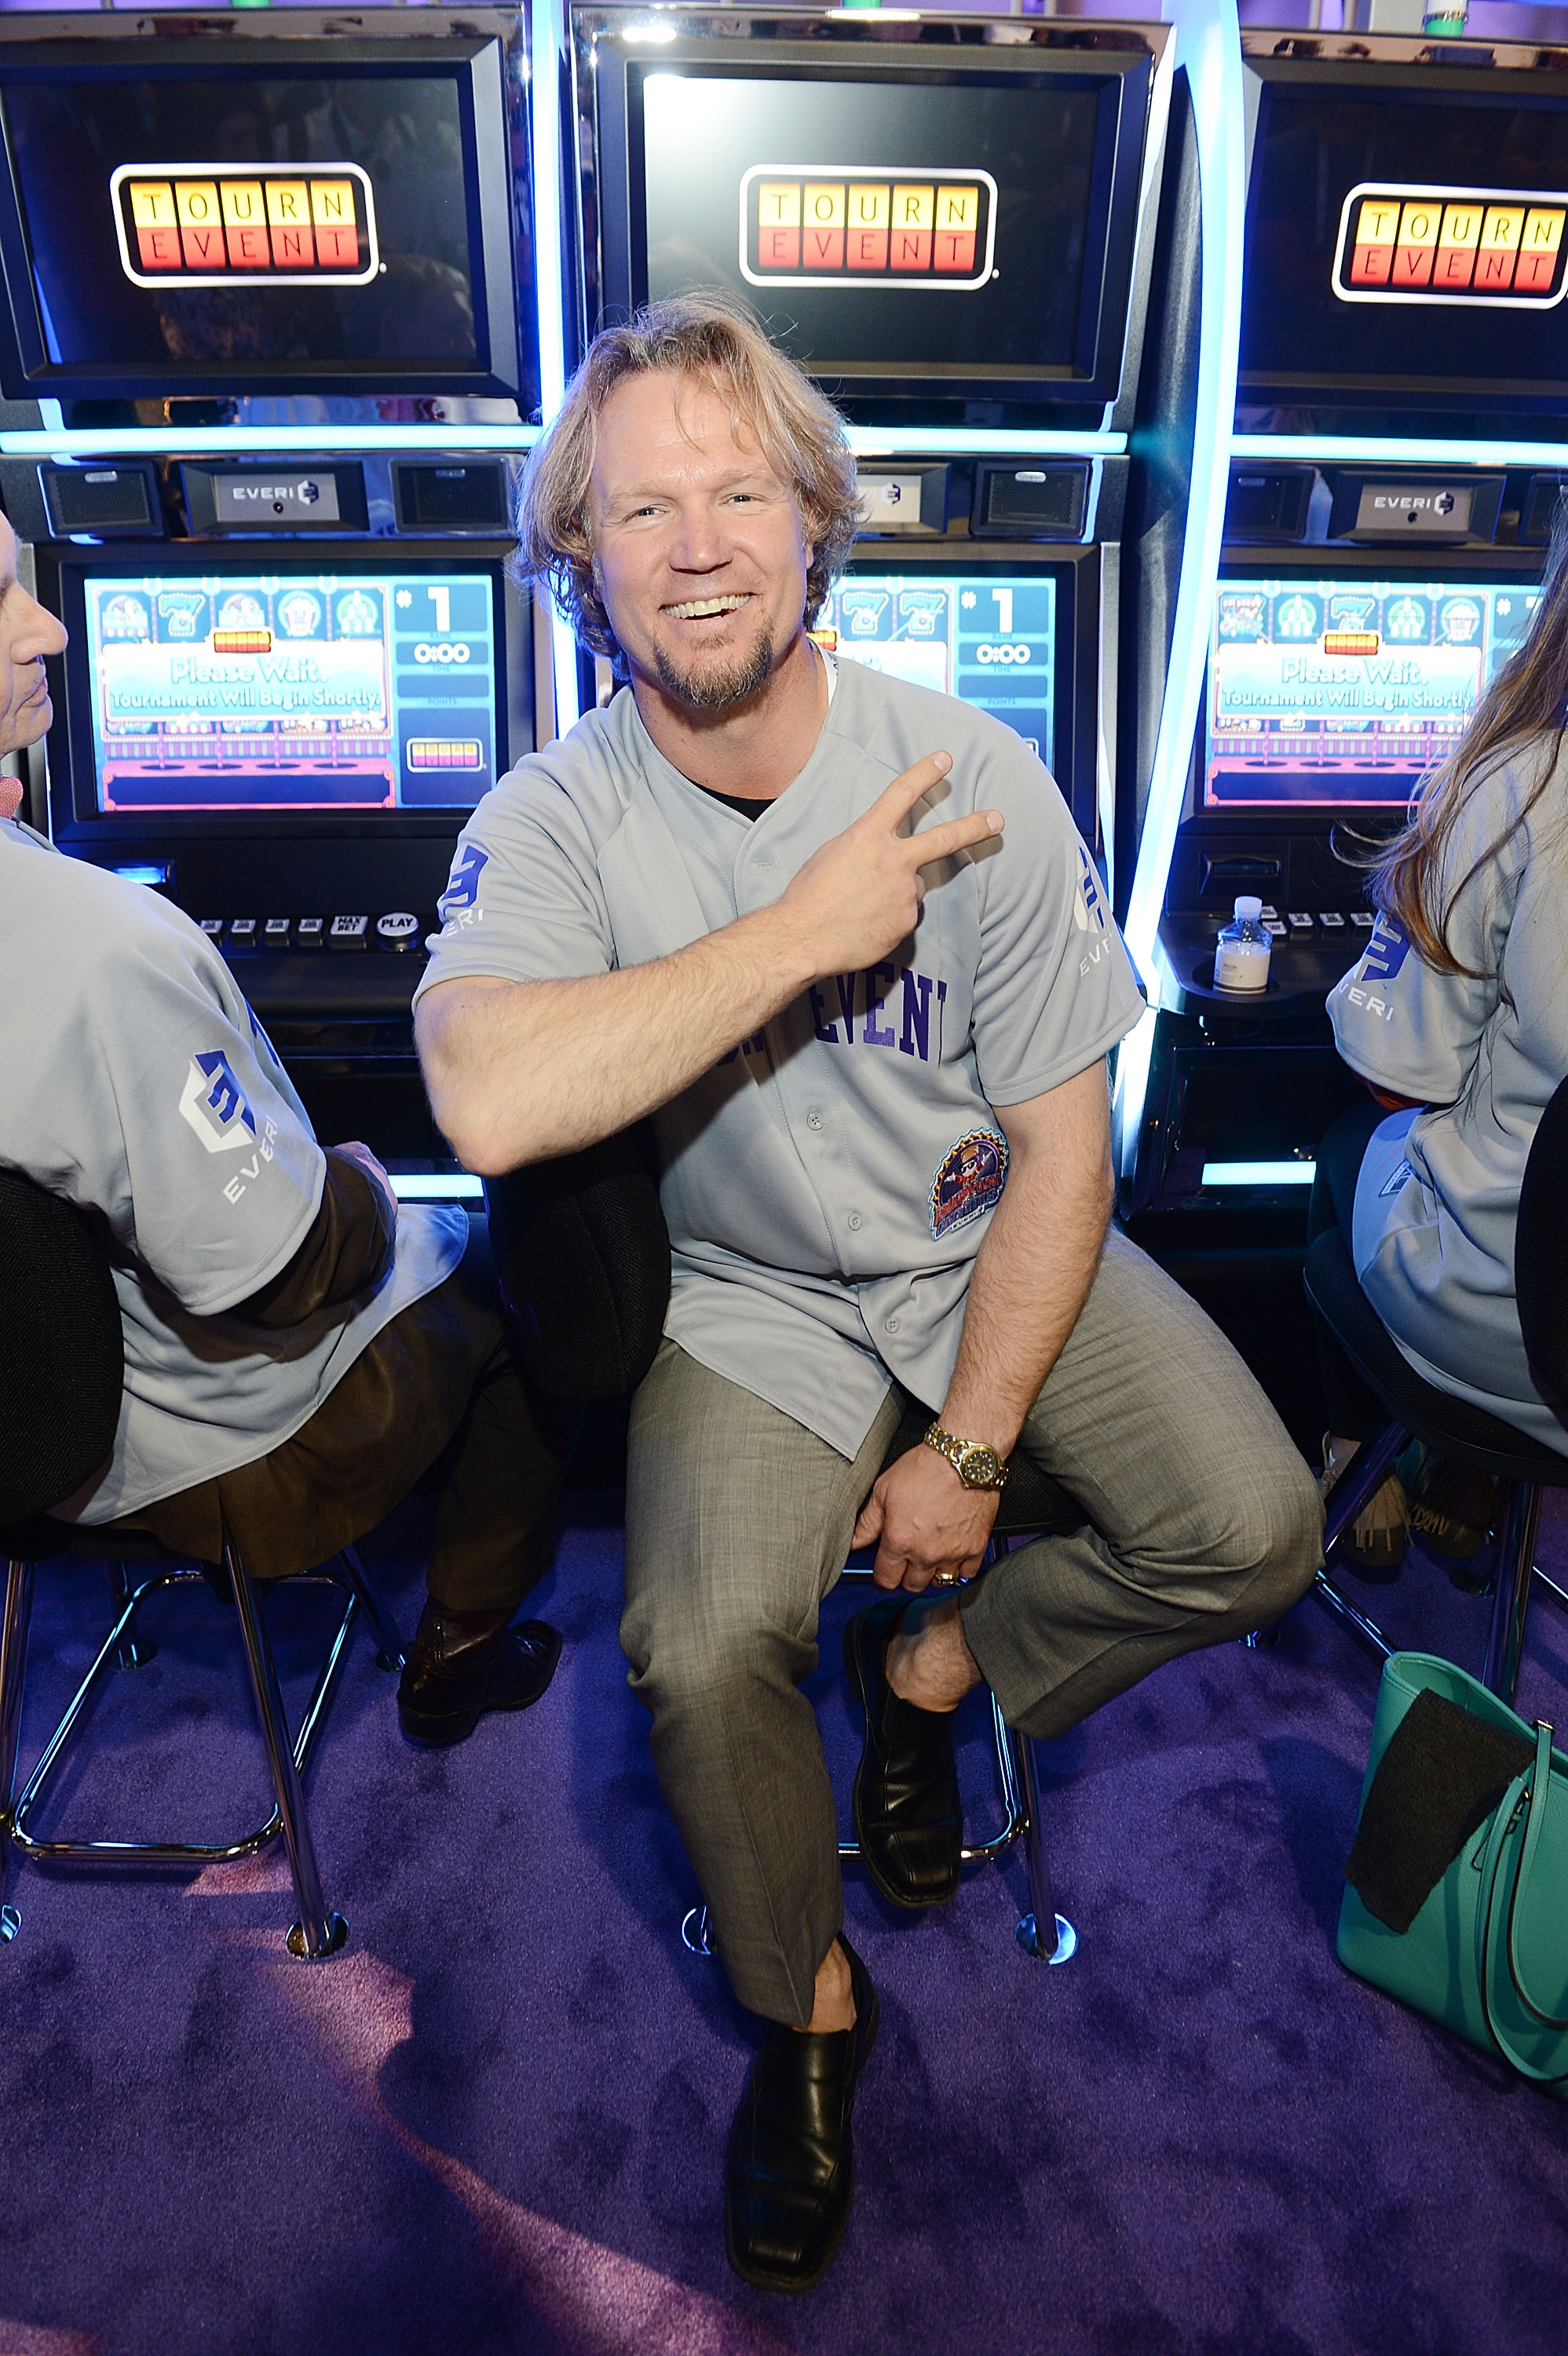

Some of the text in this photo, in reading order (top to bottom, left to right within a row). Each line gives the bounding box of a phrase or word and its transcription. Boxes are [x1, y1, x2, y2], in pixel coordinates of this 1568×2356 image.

[143, 192, 342, 219] TOURN
[772, 193, 966, 223] TOURN
[1372, 211, 1552, 244] TOURN
[151, 229, 345, 259] EVENT
[773, 232, 964, 261] EVENT
[1364, 249, 1547, 281] EVENT
[232, 485, 294, 500] EVERI
[1373, 496, 1431, 510] EVERI
[427, 585, 451, 632] 1
[991, 588, 1013, 634] 1
[413, 642, 471, 664] 0:00
[975, 643, 1032, 665] 0:00
[170, 654, 328, 685] Please Wait.
[1281, 657, 1428, 686] Please Wait.
[111, 687, 382, 712] Tournament Will Begin Shortly.
[1223, 688, 1324, 707] Tournament
[1326, 689, 1360, 707] Will
[1362, 690, 1409, 712] Begin
[381, 918, 413, 928] PLAY
[223, 1114, 278, 1205] EVERI
